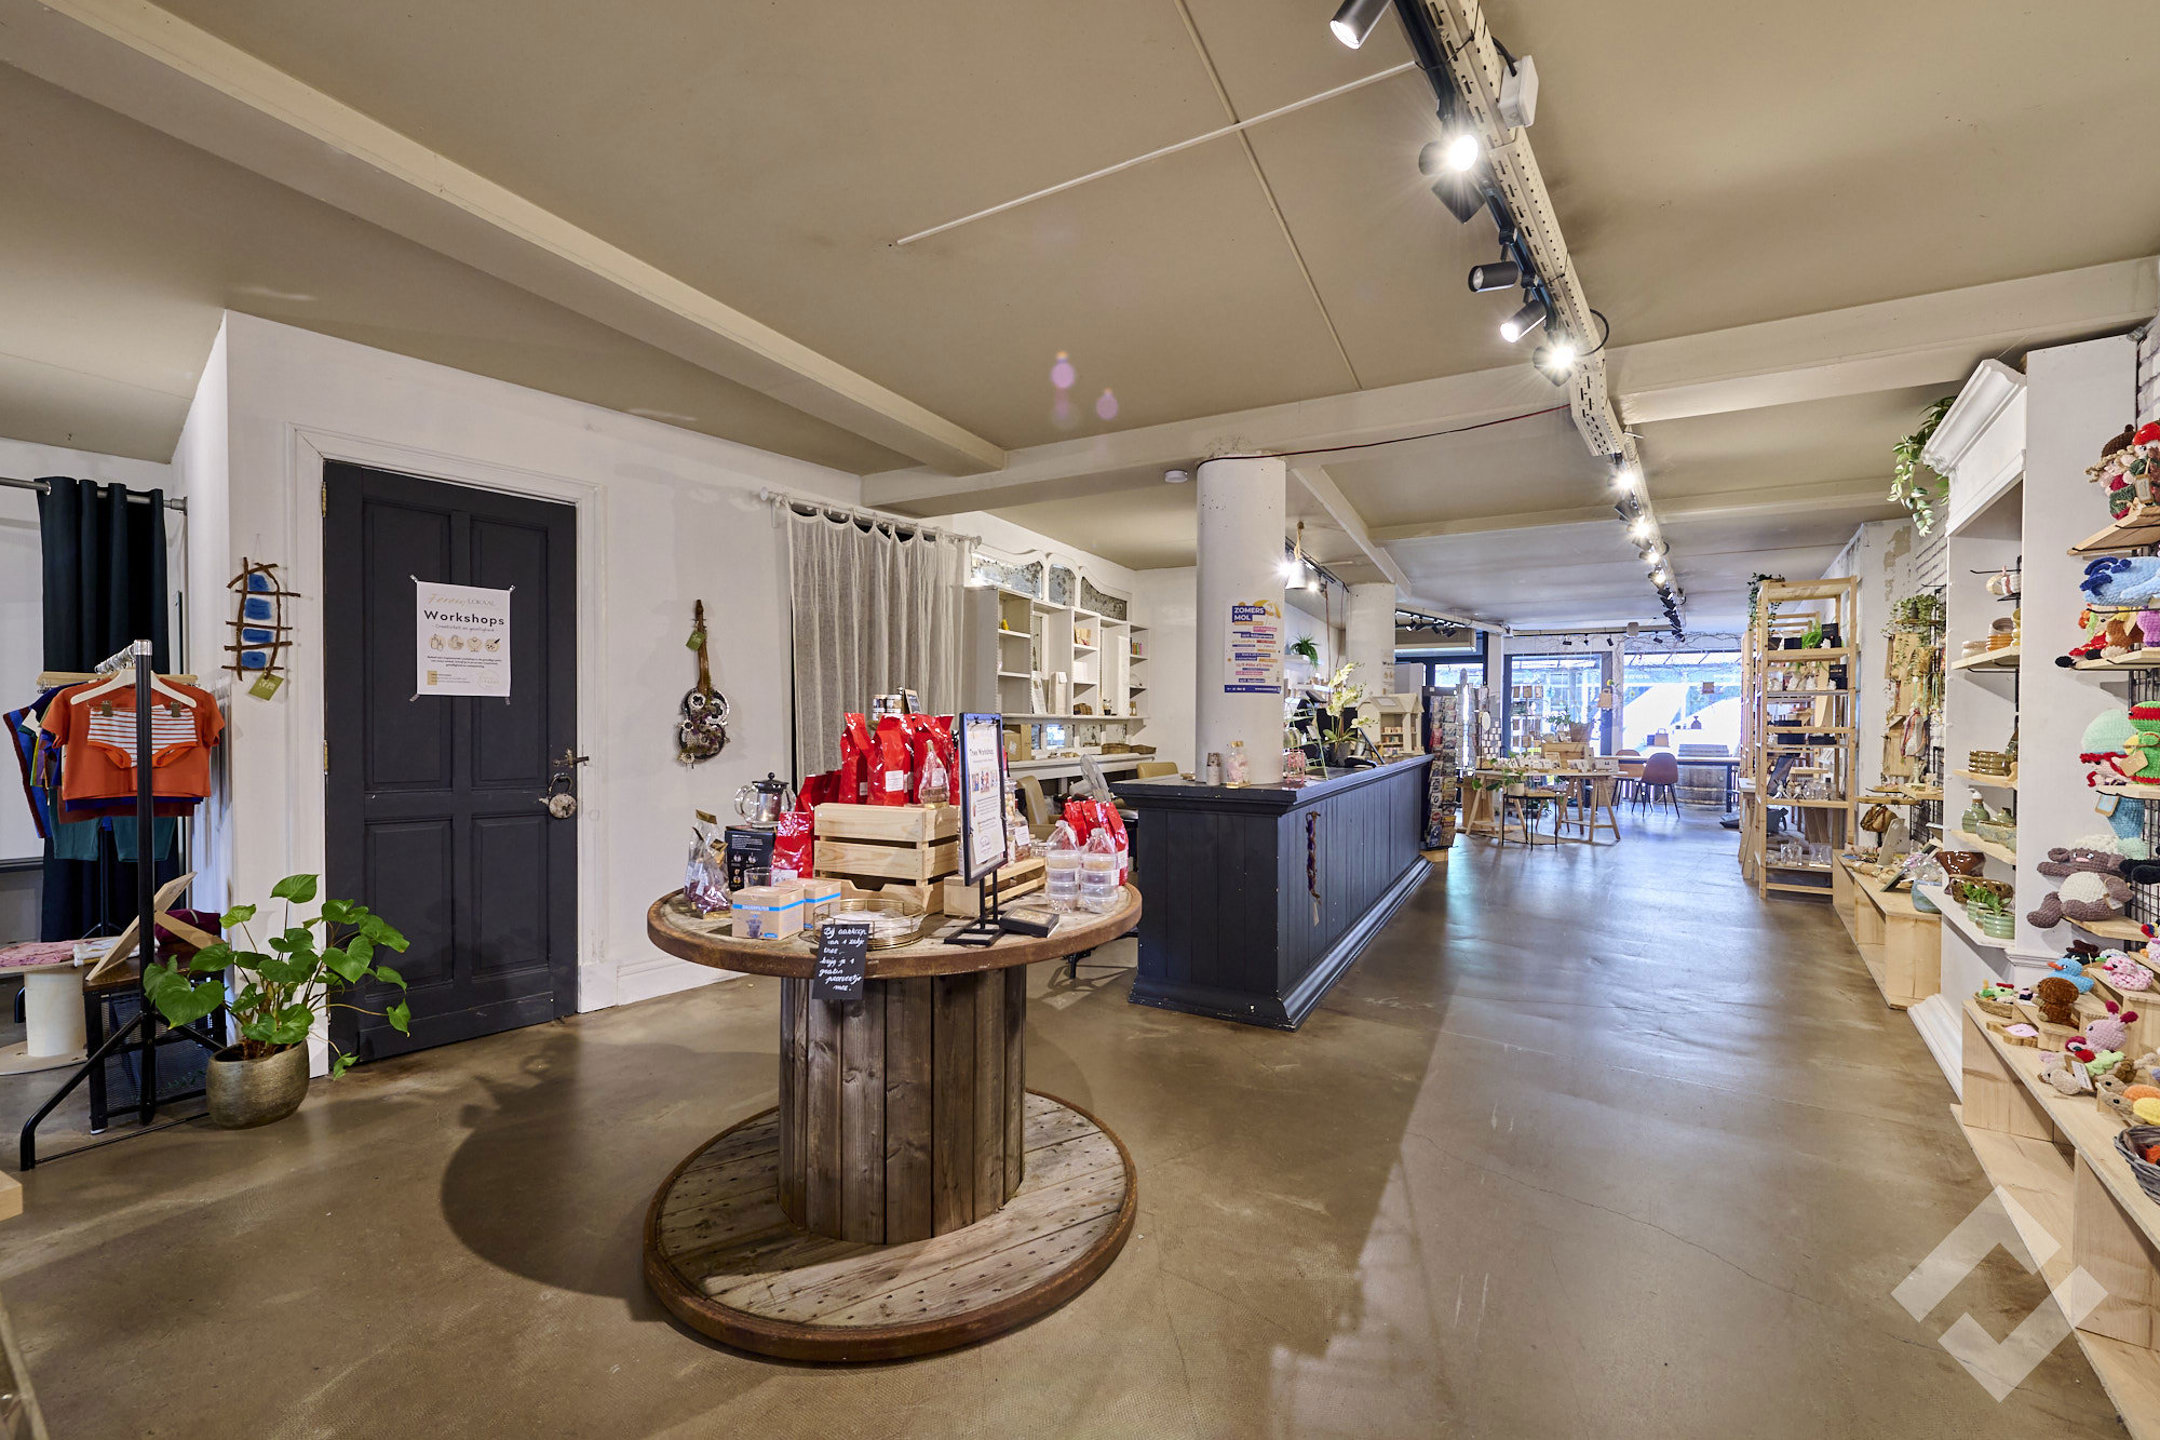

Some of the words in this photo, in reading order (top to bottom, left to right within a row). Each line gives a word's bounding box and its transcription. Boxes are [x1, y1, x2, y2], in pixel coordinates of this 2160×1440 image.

[1233, 606, 1265, 614] ZOMERS
[423, 609, 504, 626] Workshops
[850, 957, 855, 965] 1
